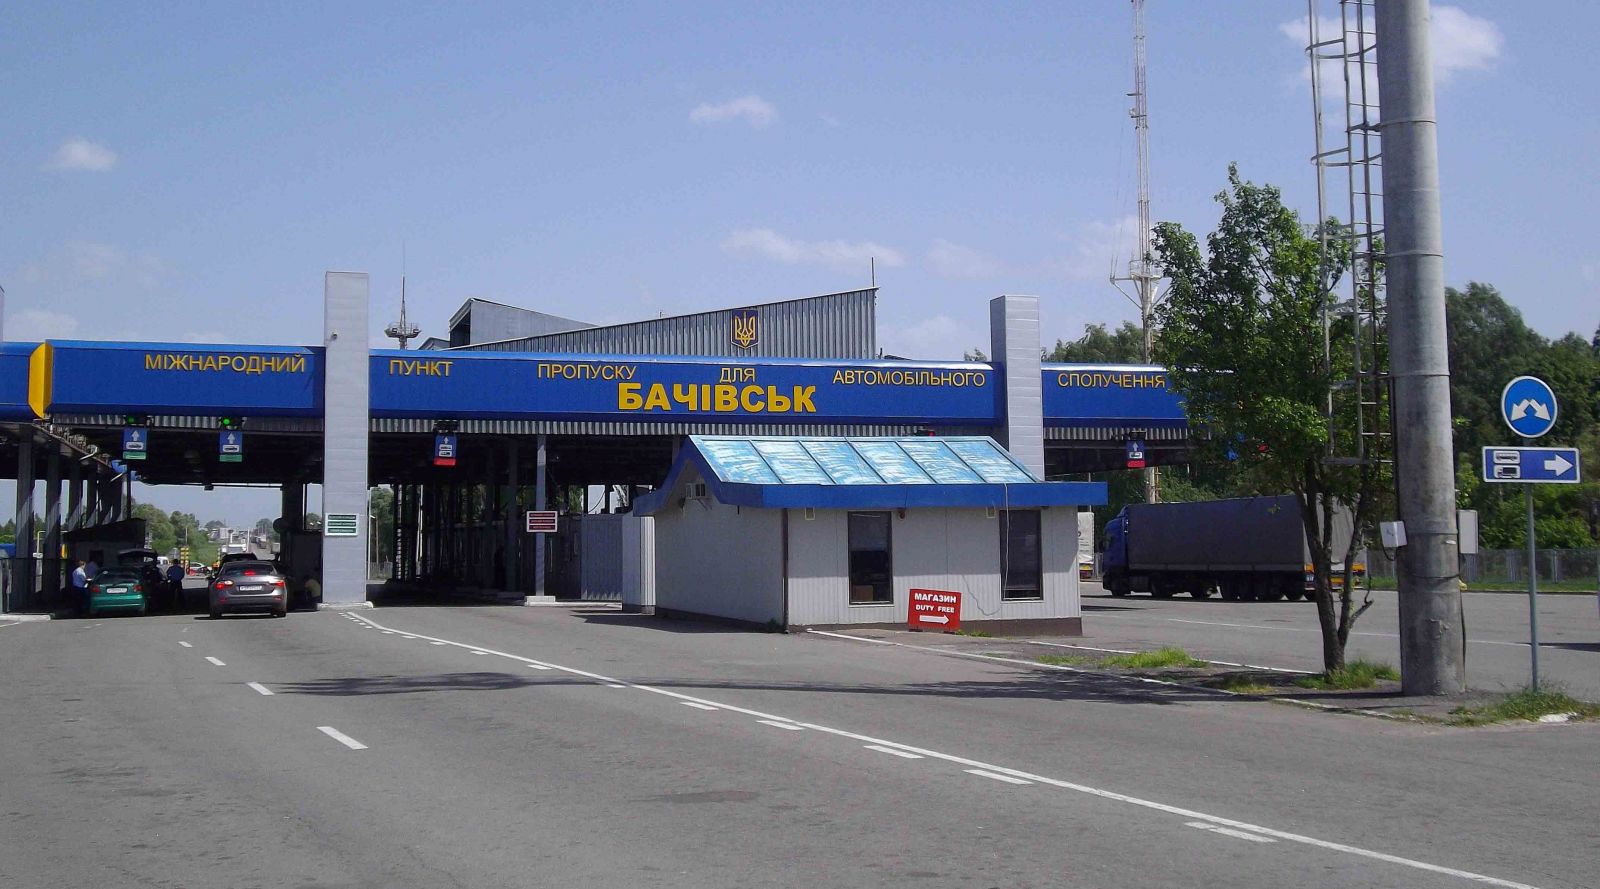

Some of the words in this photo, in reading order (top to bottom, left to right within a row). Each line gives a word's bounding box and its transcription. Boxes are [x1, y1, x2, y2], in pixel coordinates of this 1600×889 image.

[144, 353, 305, 374] МІЖНАРОДНИЙ
[389, 360, 453, 377] ПУНКТ
[538, 364, 637, 380] ПРОПУСКУ
[719, 367, 755, 383] ДЛЯ
[833, 370, 986, 387] АВТОМОБІЛЬНОГО
[1058, 373, 1165, 388] СПОЛУЧЕННЯ
[618, 382, 816, 413] БАЧІВСЬК
[914, 593, 957, 603] МАГАЗИН
